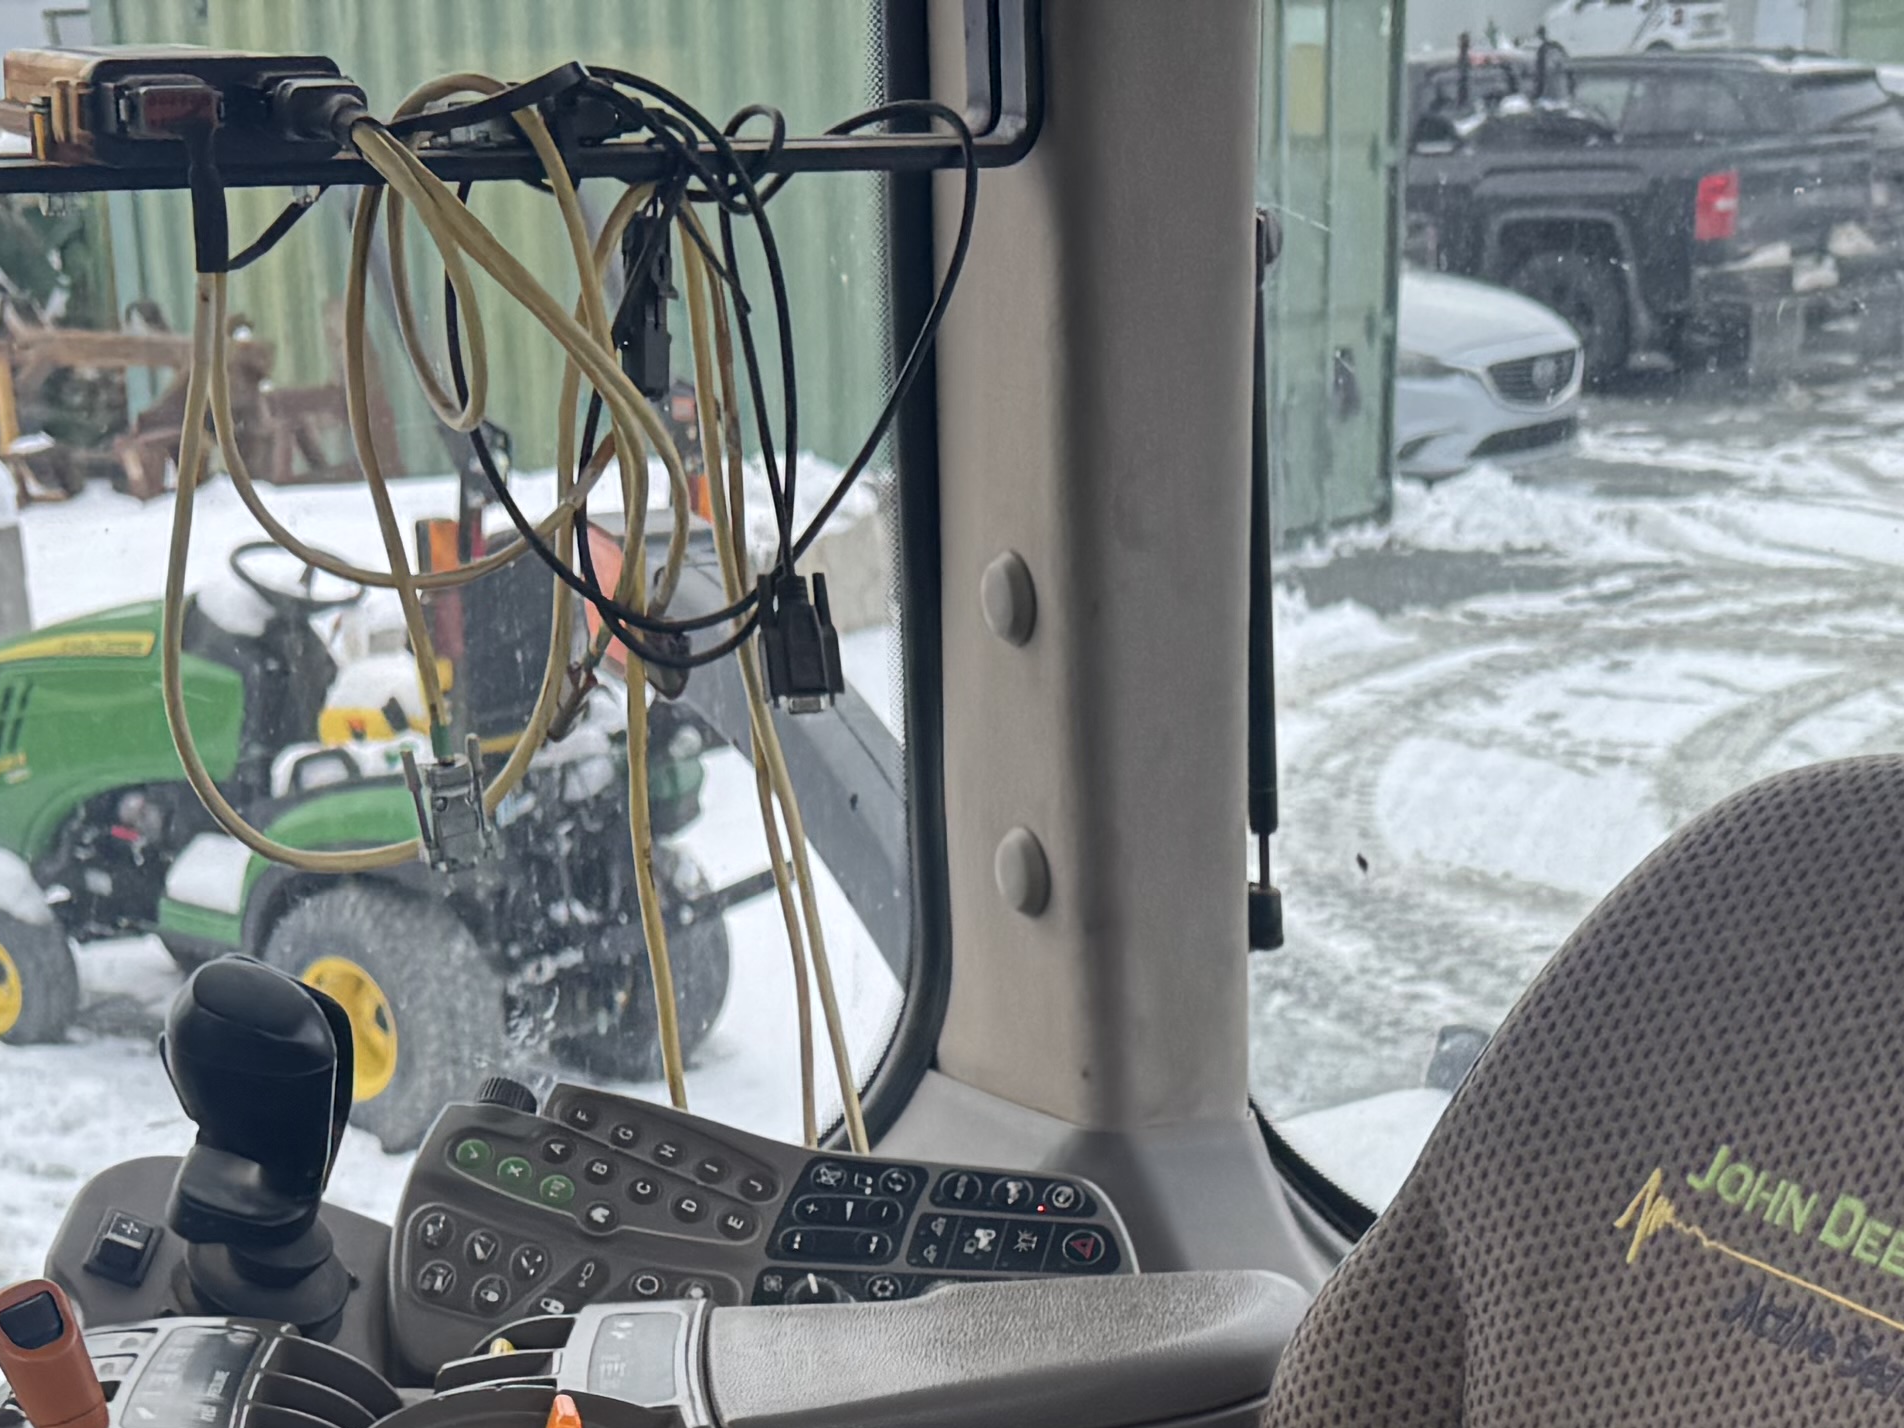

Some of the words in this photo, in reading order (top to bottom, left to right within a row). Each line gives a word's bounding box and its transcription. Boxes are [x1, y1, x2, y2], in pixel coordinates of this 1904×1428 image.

[576, 1109, 589, 1122] F
[618, 1127, 634, 1140] G
[549, 1142, 567, 1156] A
[659, 1143, 676, 1158] H
[591, 1161, 608, 1176] B
[704, 1163, 719, 1174] I
[636, 1181, 652, 1195] C
[749, 1179, 763, 1193] J
[1686, 1144, 1820, 1235] JOHN
[681, 1199, 697, 1213] D
[727, 1215, 744, 1230] E
